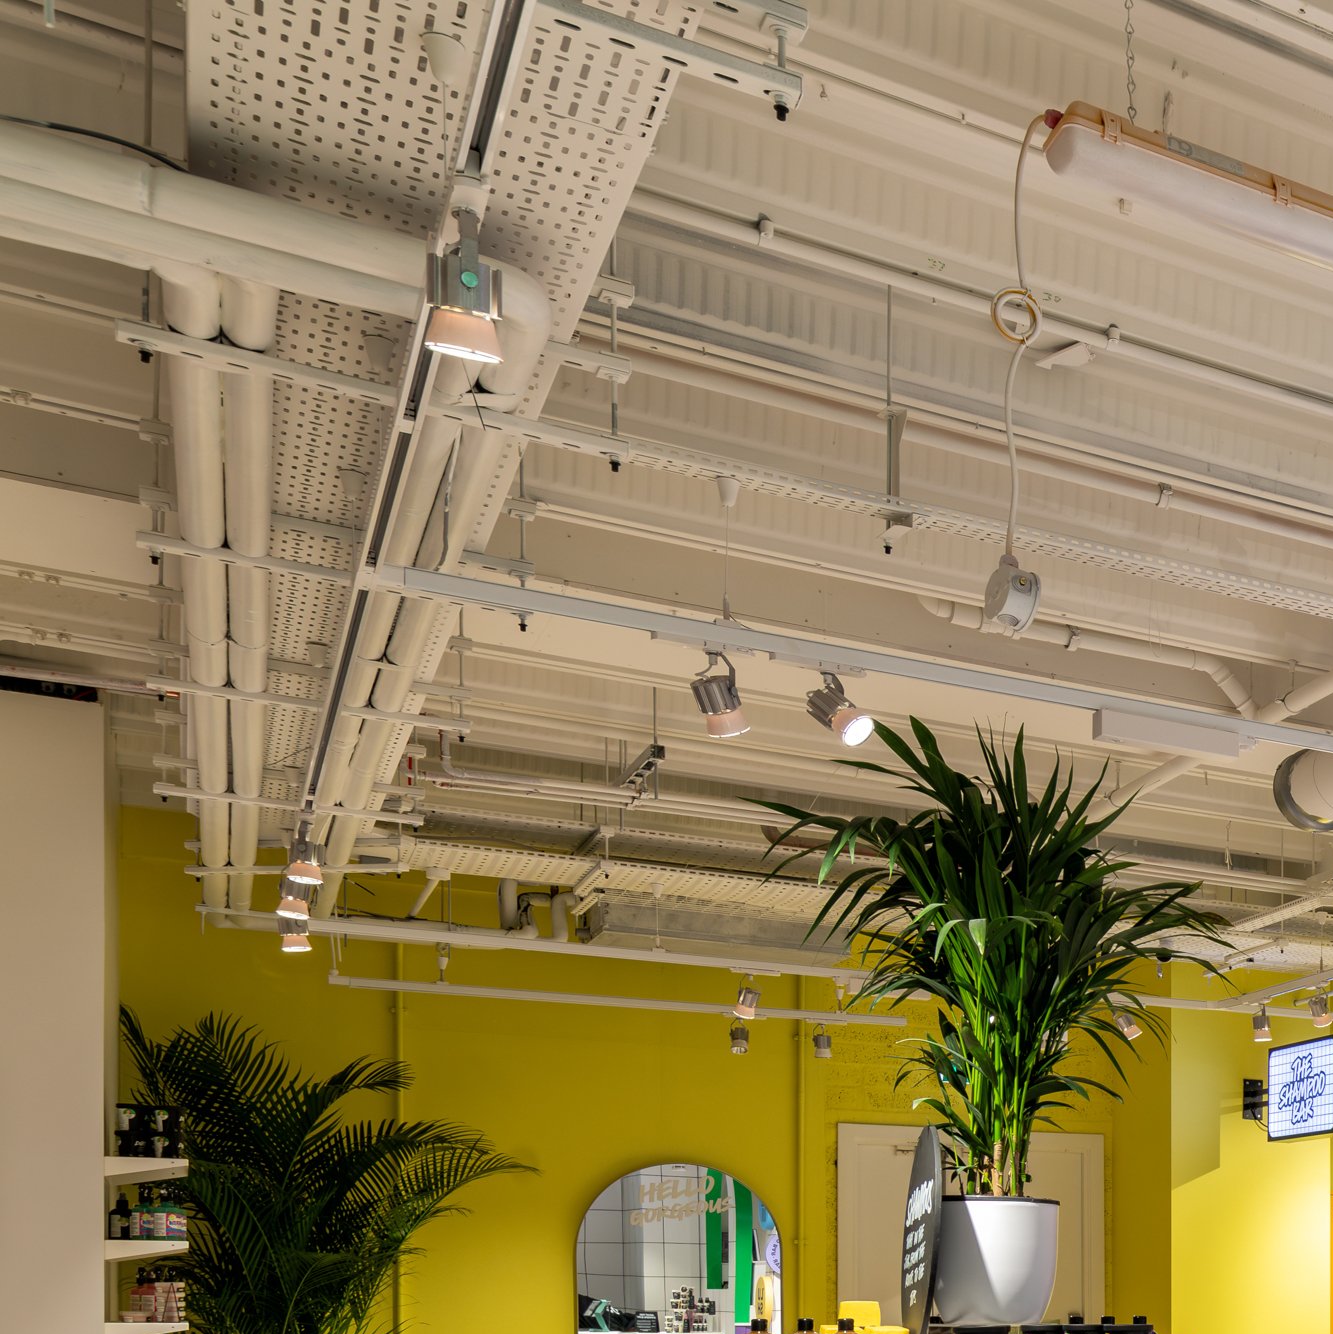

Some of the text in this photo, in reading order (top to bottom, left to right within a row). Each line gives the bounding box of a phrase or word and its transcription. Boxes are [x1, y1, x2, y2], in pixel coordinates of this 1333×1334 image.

[1291, 1053, 1312, 1082] THE
[1278, 1070, 1326, 1110] SHAMPOO
[1291, 1097, 1314, 1125] BAR
[639, 1175, 715, 1204] HELLO
[629, 1196, 732, 1227] GORGEOUS
